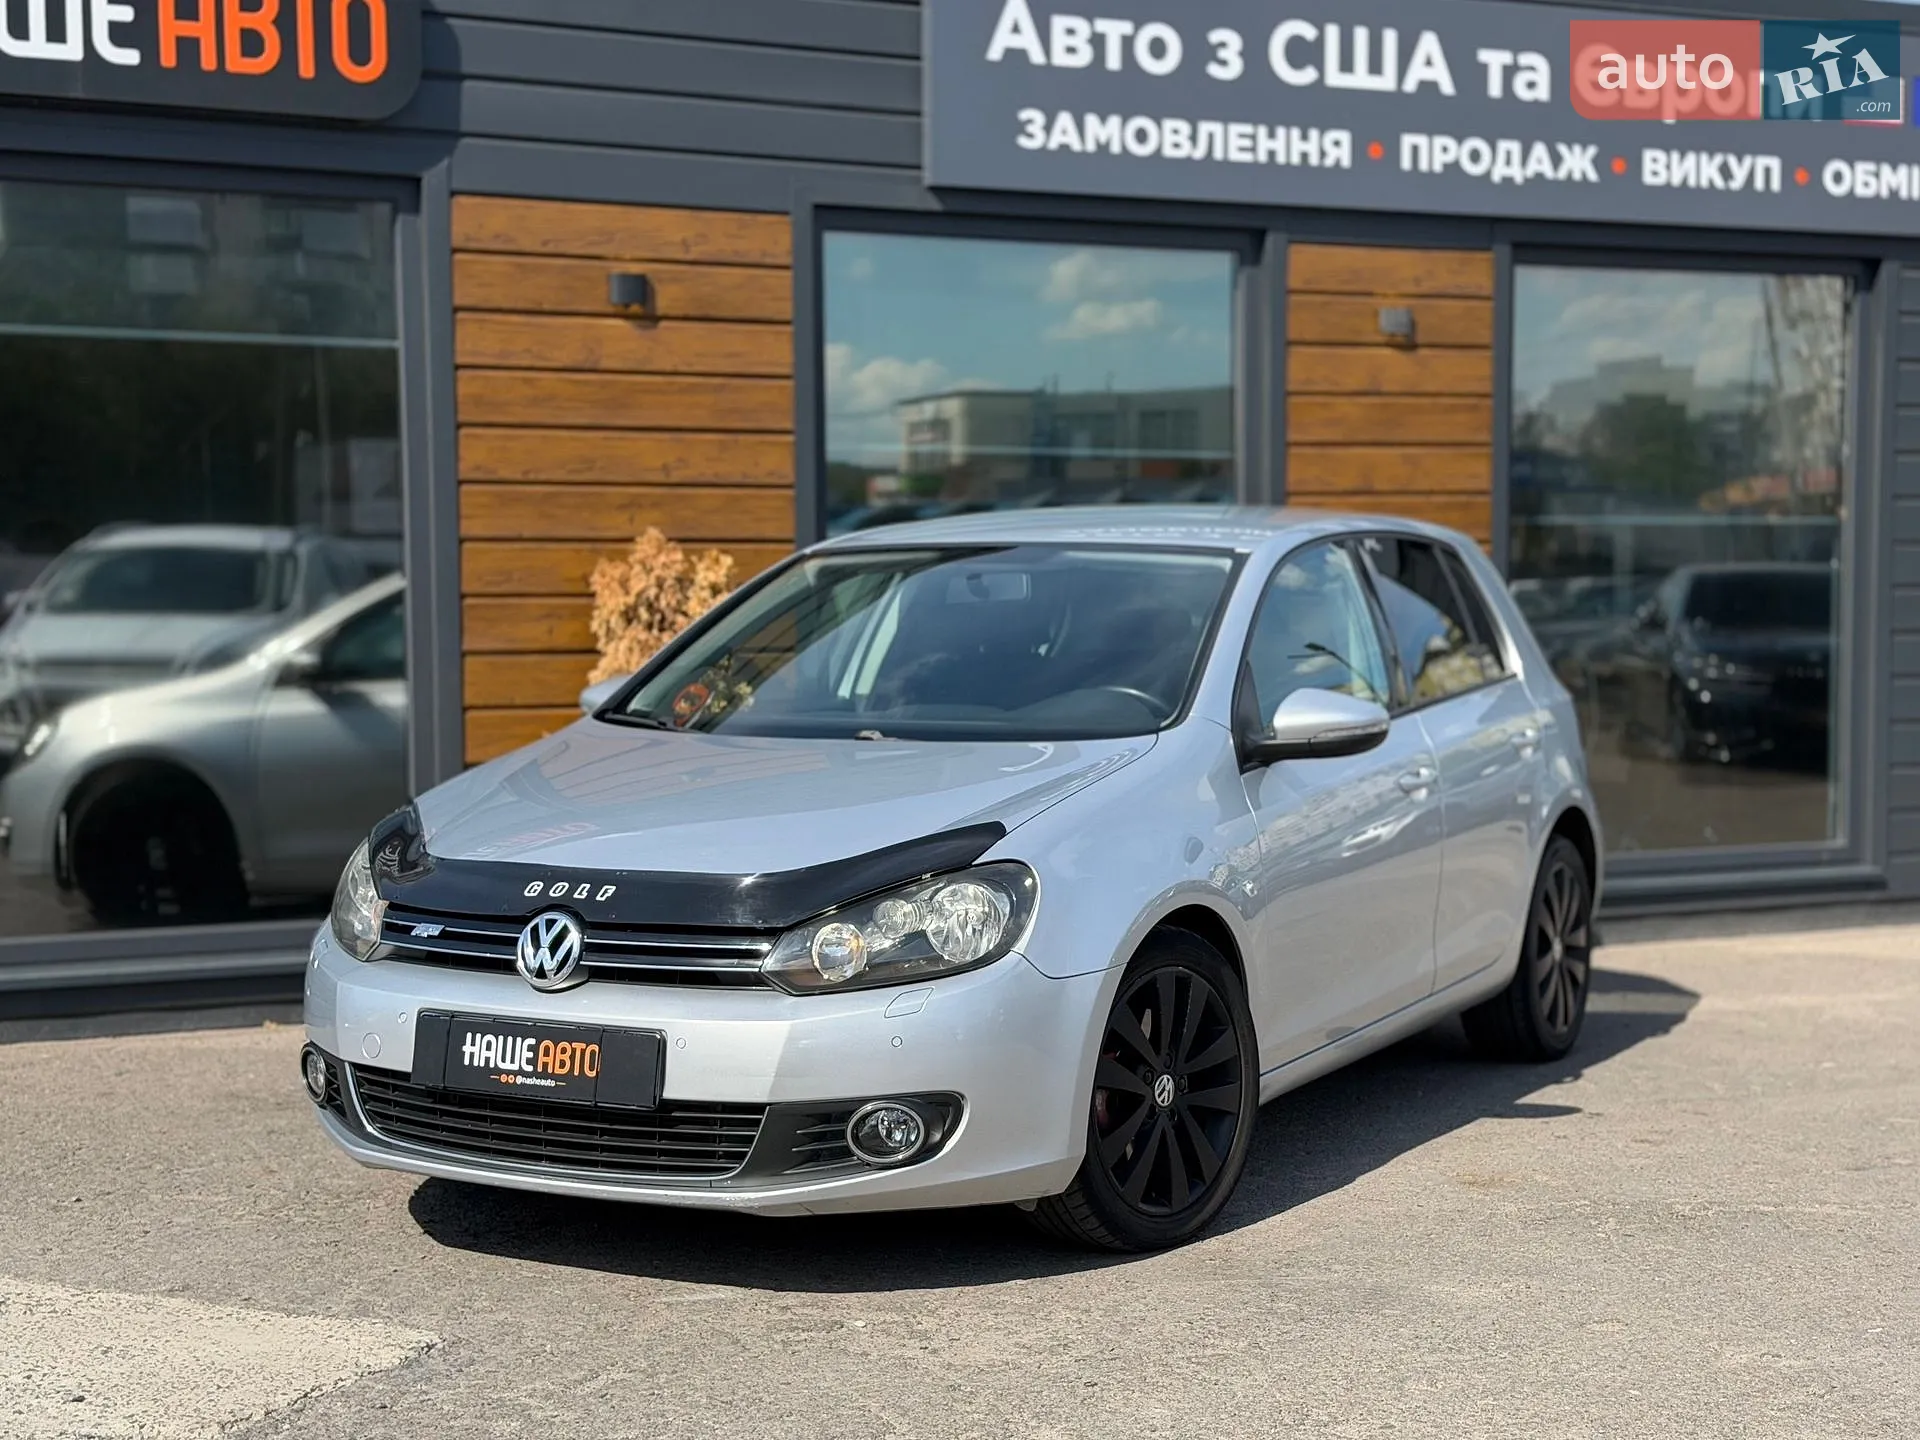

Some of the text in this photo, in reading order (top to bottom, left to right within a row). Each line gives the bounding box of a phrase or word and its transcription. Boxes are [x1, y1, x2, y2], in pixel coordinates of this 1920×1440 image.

[985, 0, 1183, 76] Авто
[1205, 28, 1244, 82] з
[1268, 19, 1456, 96] США
[1476, 47, 1552, 103] та
[1016, 108, 1352, 169] ЗАМОВЛЕННЯ
[1400, 132, 1600, 186] ПРОДАЖ
[1641, 148, 1783, 193] ВИКУП
[523, 880, 617, 901] GOLF
[462, 1032, 601, 1077] НАШЕ АВТО
